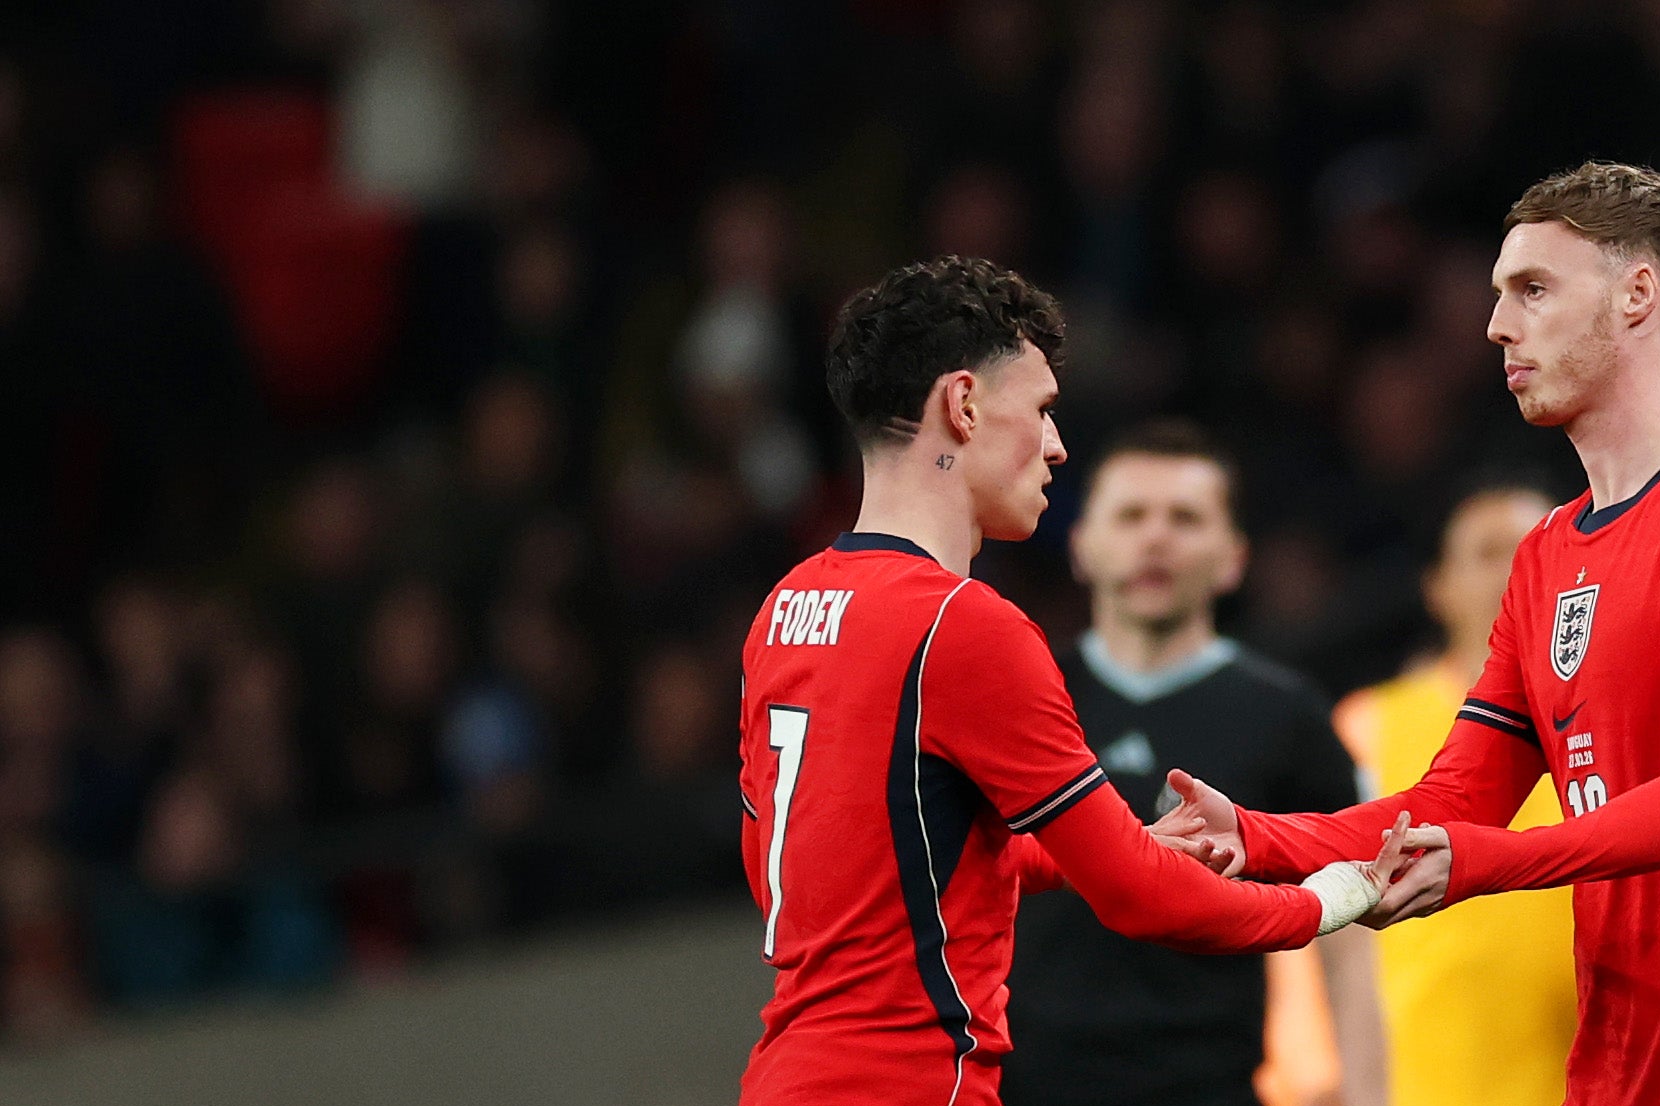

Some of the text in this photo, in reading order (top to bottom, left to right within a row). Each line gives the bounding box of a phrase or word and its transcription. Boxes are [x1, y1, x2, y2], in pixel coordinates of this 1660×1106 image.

[935, 454, 955, 471] 47
[766, 589, 855, 646] FODEN
[764, 706, 810, 958] 7
